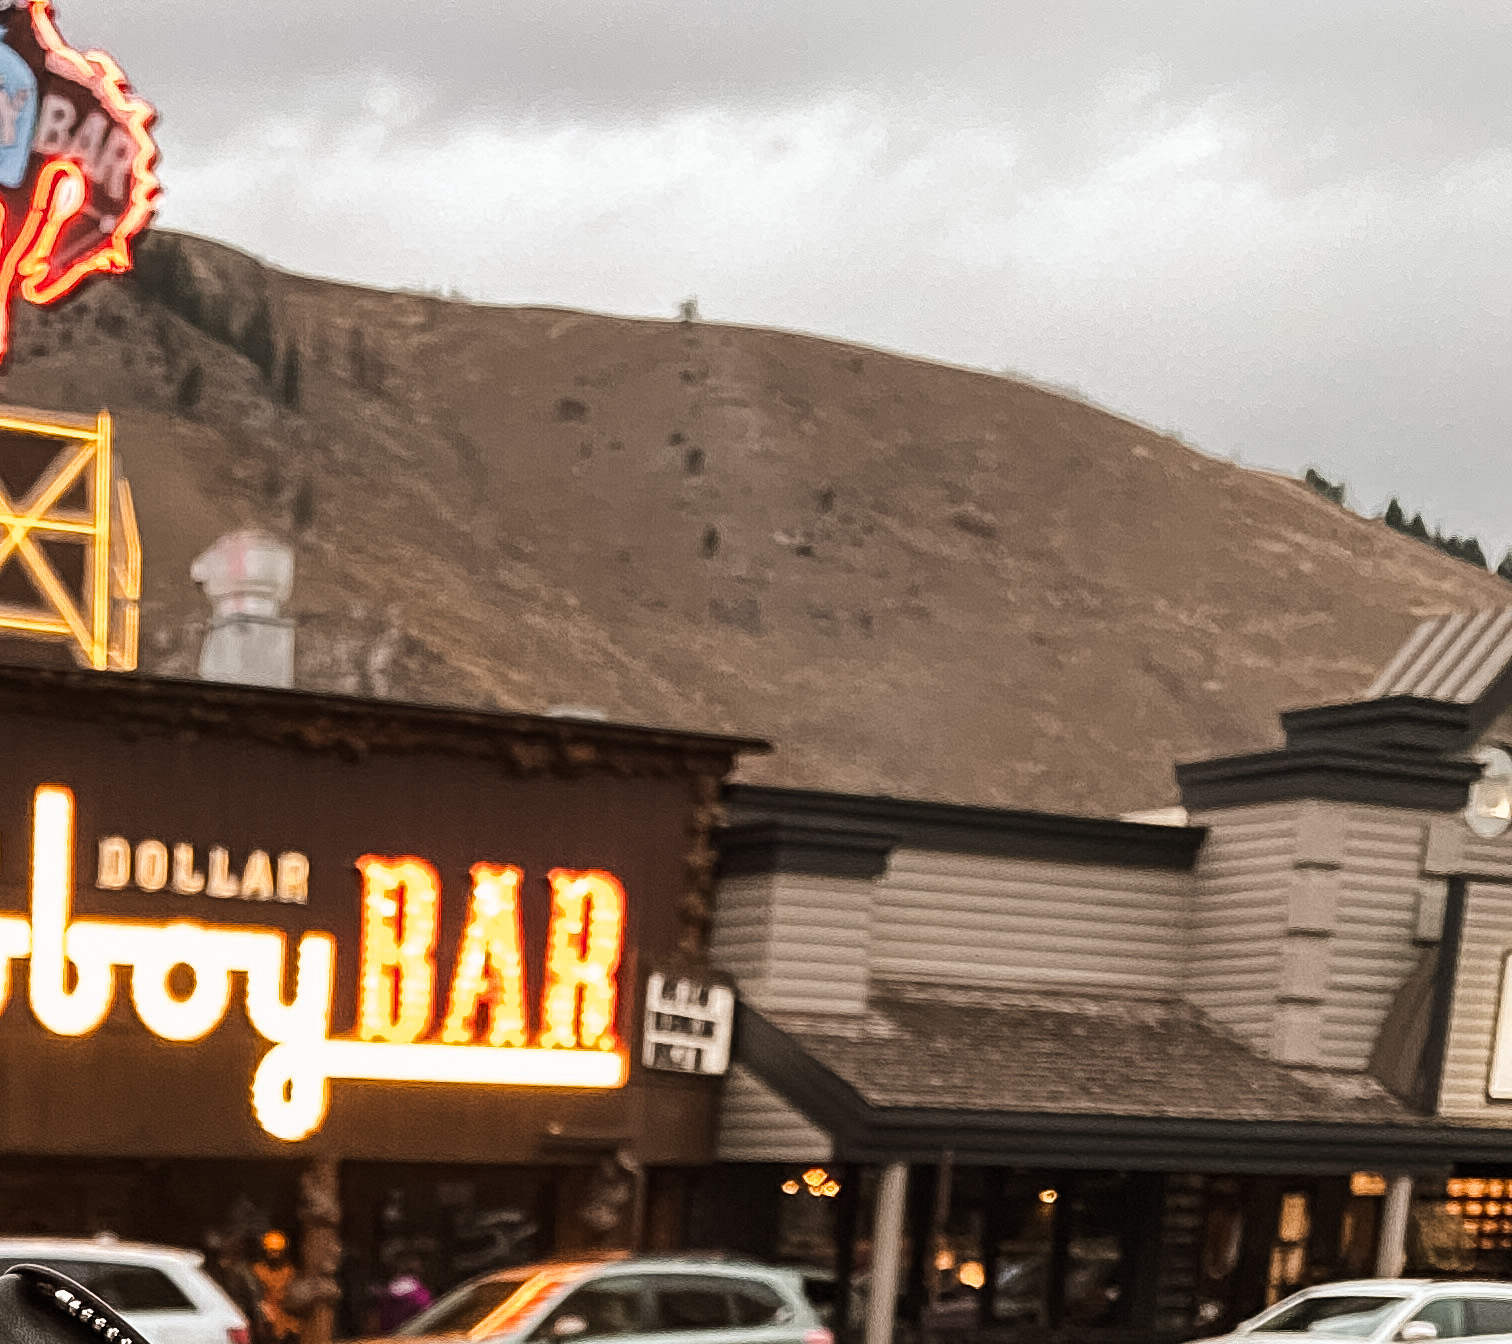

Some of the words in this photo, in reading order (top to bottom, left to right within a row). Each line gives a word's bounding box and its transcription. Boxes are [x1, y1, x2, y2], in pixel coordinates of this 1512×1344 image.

[37, 95, 133, 200] BAR
[96, 836, 311, 904] DOLLAR
[354, 854, 628, 1046] BAR
